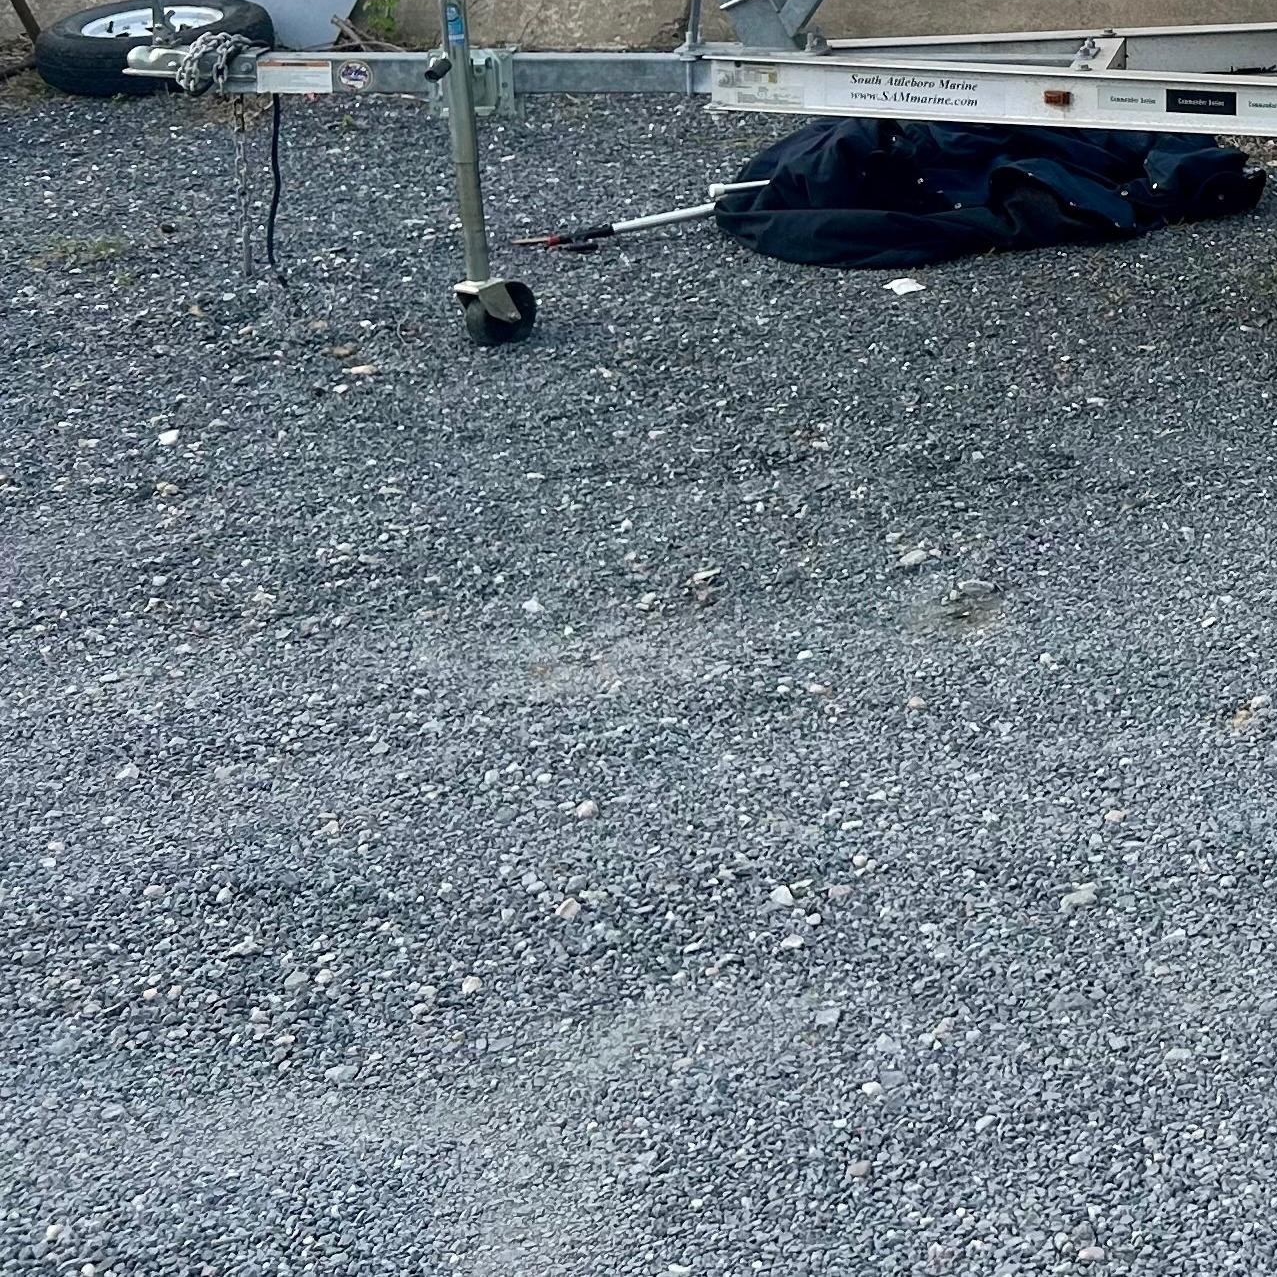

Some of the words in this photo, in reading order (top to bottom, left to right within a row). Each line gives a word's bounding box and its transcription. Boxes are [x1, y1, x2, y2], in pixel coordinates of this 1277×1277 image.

[850, 73, 882, 86] South
[886, 75, 936, 89] Attleboro
[938, 79, 978, 92] Marine
[850, 90, 978, 107] www.SAMmarine.com
